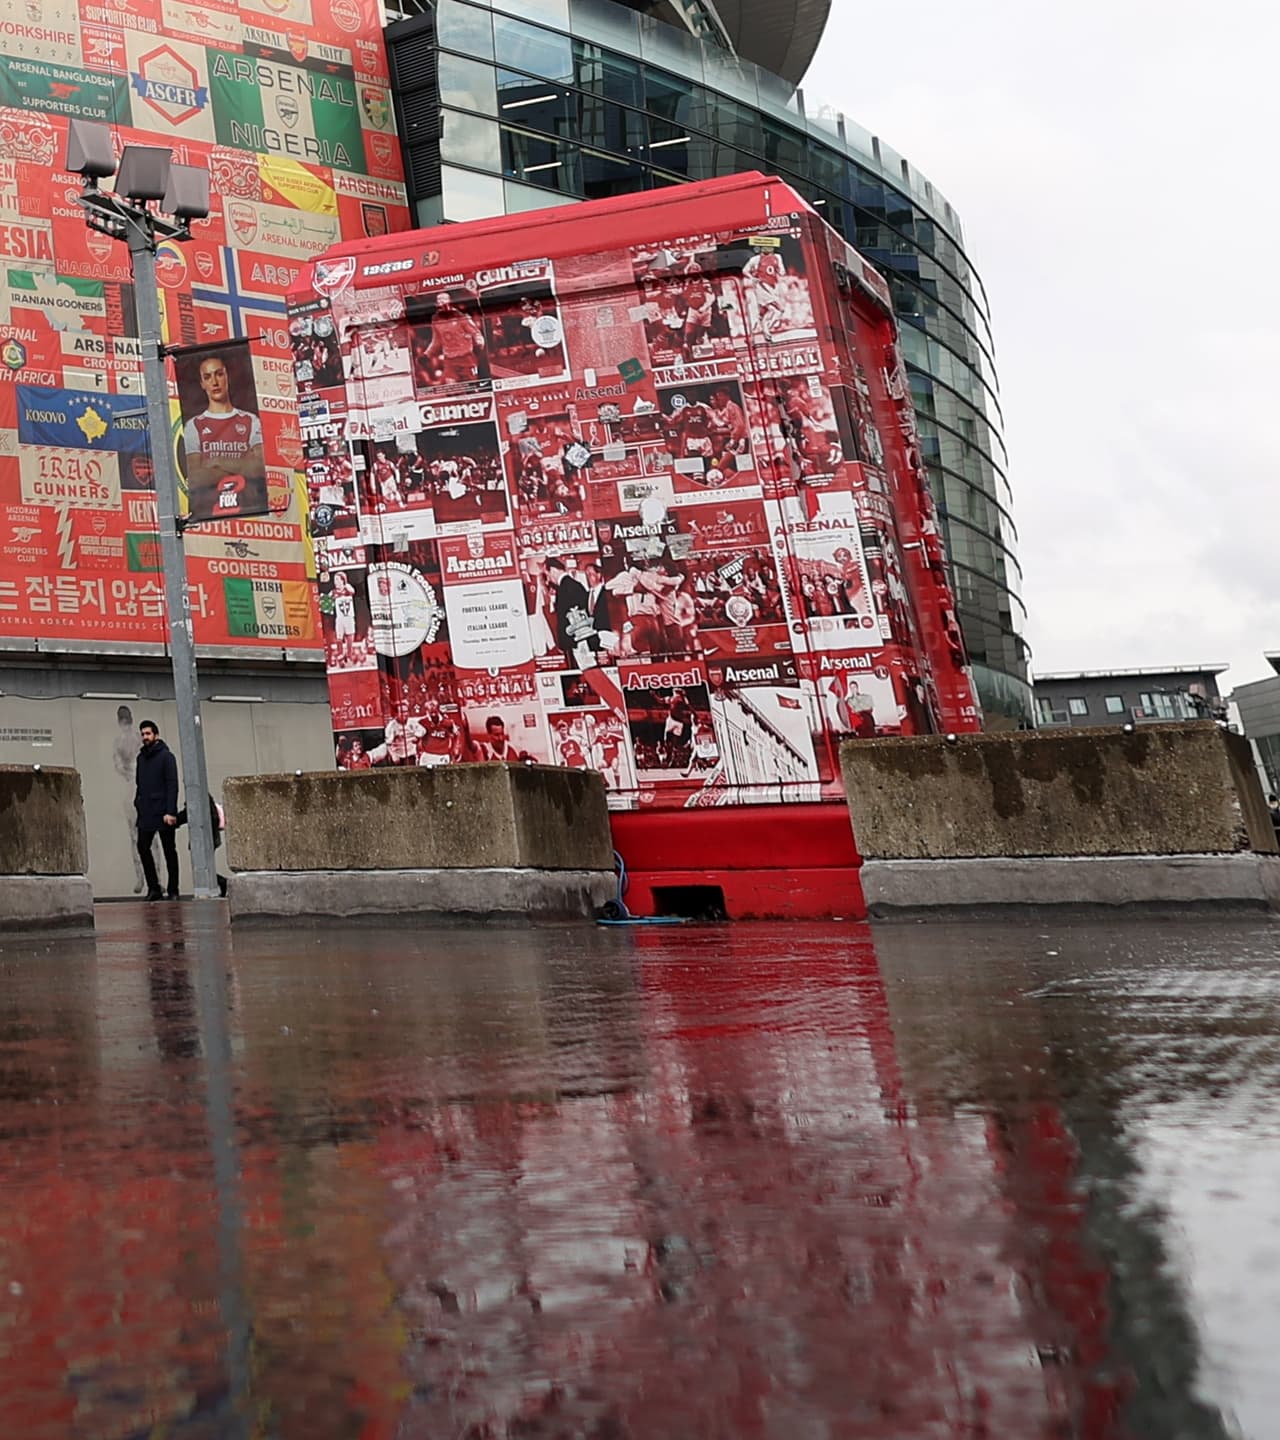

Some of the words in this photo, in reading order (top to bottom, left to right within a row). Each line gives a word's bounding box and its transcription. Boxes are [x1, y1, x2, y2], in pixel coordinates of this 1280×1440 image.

[9, 62, 51, 77] ARSENAL
[54, 69, 114, 86] BANGLADESH
[214, 54, 352, 106] ARSENAL
[145, 84, 196, 106] ASCFR
[21, 94, 79, 114] SUPPORTERS
[81, 103, 107, 118] CLUB
[231, 120, 350, 166] NIGERIA
[476, 263, 542, 287] Gunner
[11, 293, 54, 307] IRANIAN
[56, 297, 103, 311] GOONERS
[419, 401, 489, 425] Gunner
[202, 440, 247, 452] Emirates
[220, 492, 238, 508] FOX
[613, 521, 663, 539] Arsenal
[774, 517, 855, 537] ARSENAL
[446, 550, 513, 573] Arsenal
[250, 580, 282, 593] IRISH
[26, 577, 107, 613] 잠들지
[111, 580, 215, 617] 않습다.
[243, 623, 300, 637] GOONERS
[724, 664, 779, 680] Arsenal
[820, 655, 872, 670] Arsenal
[626, 669, 702, 689] Arsenal
